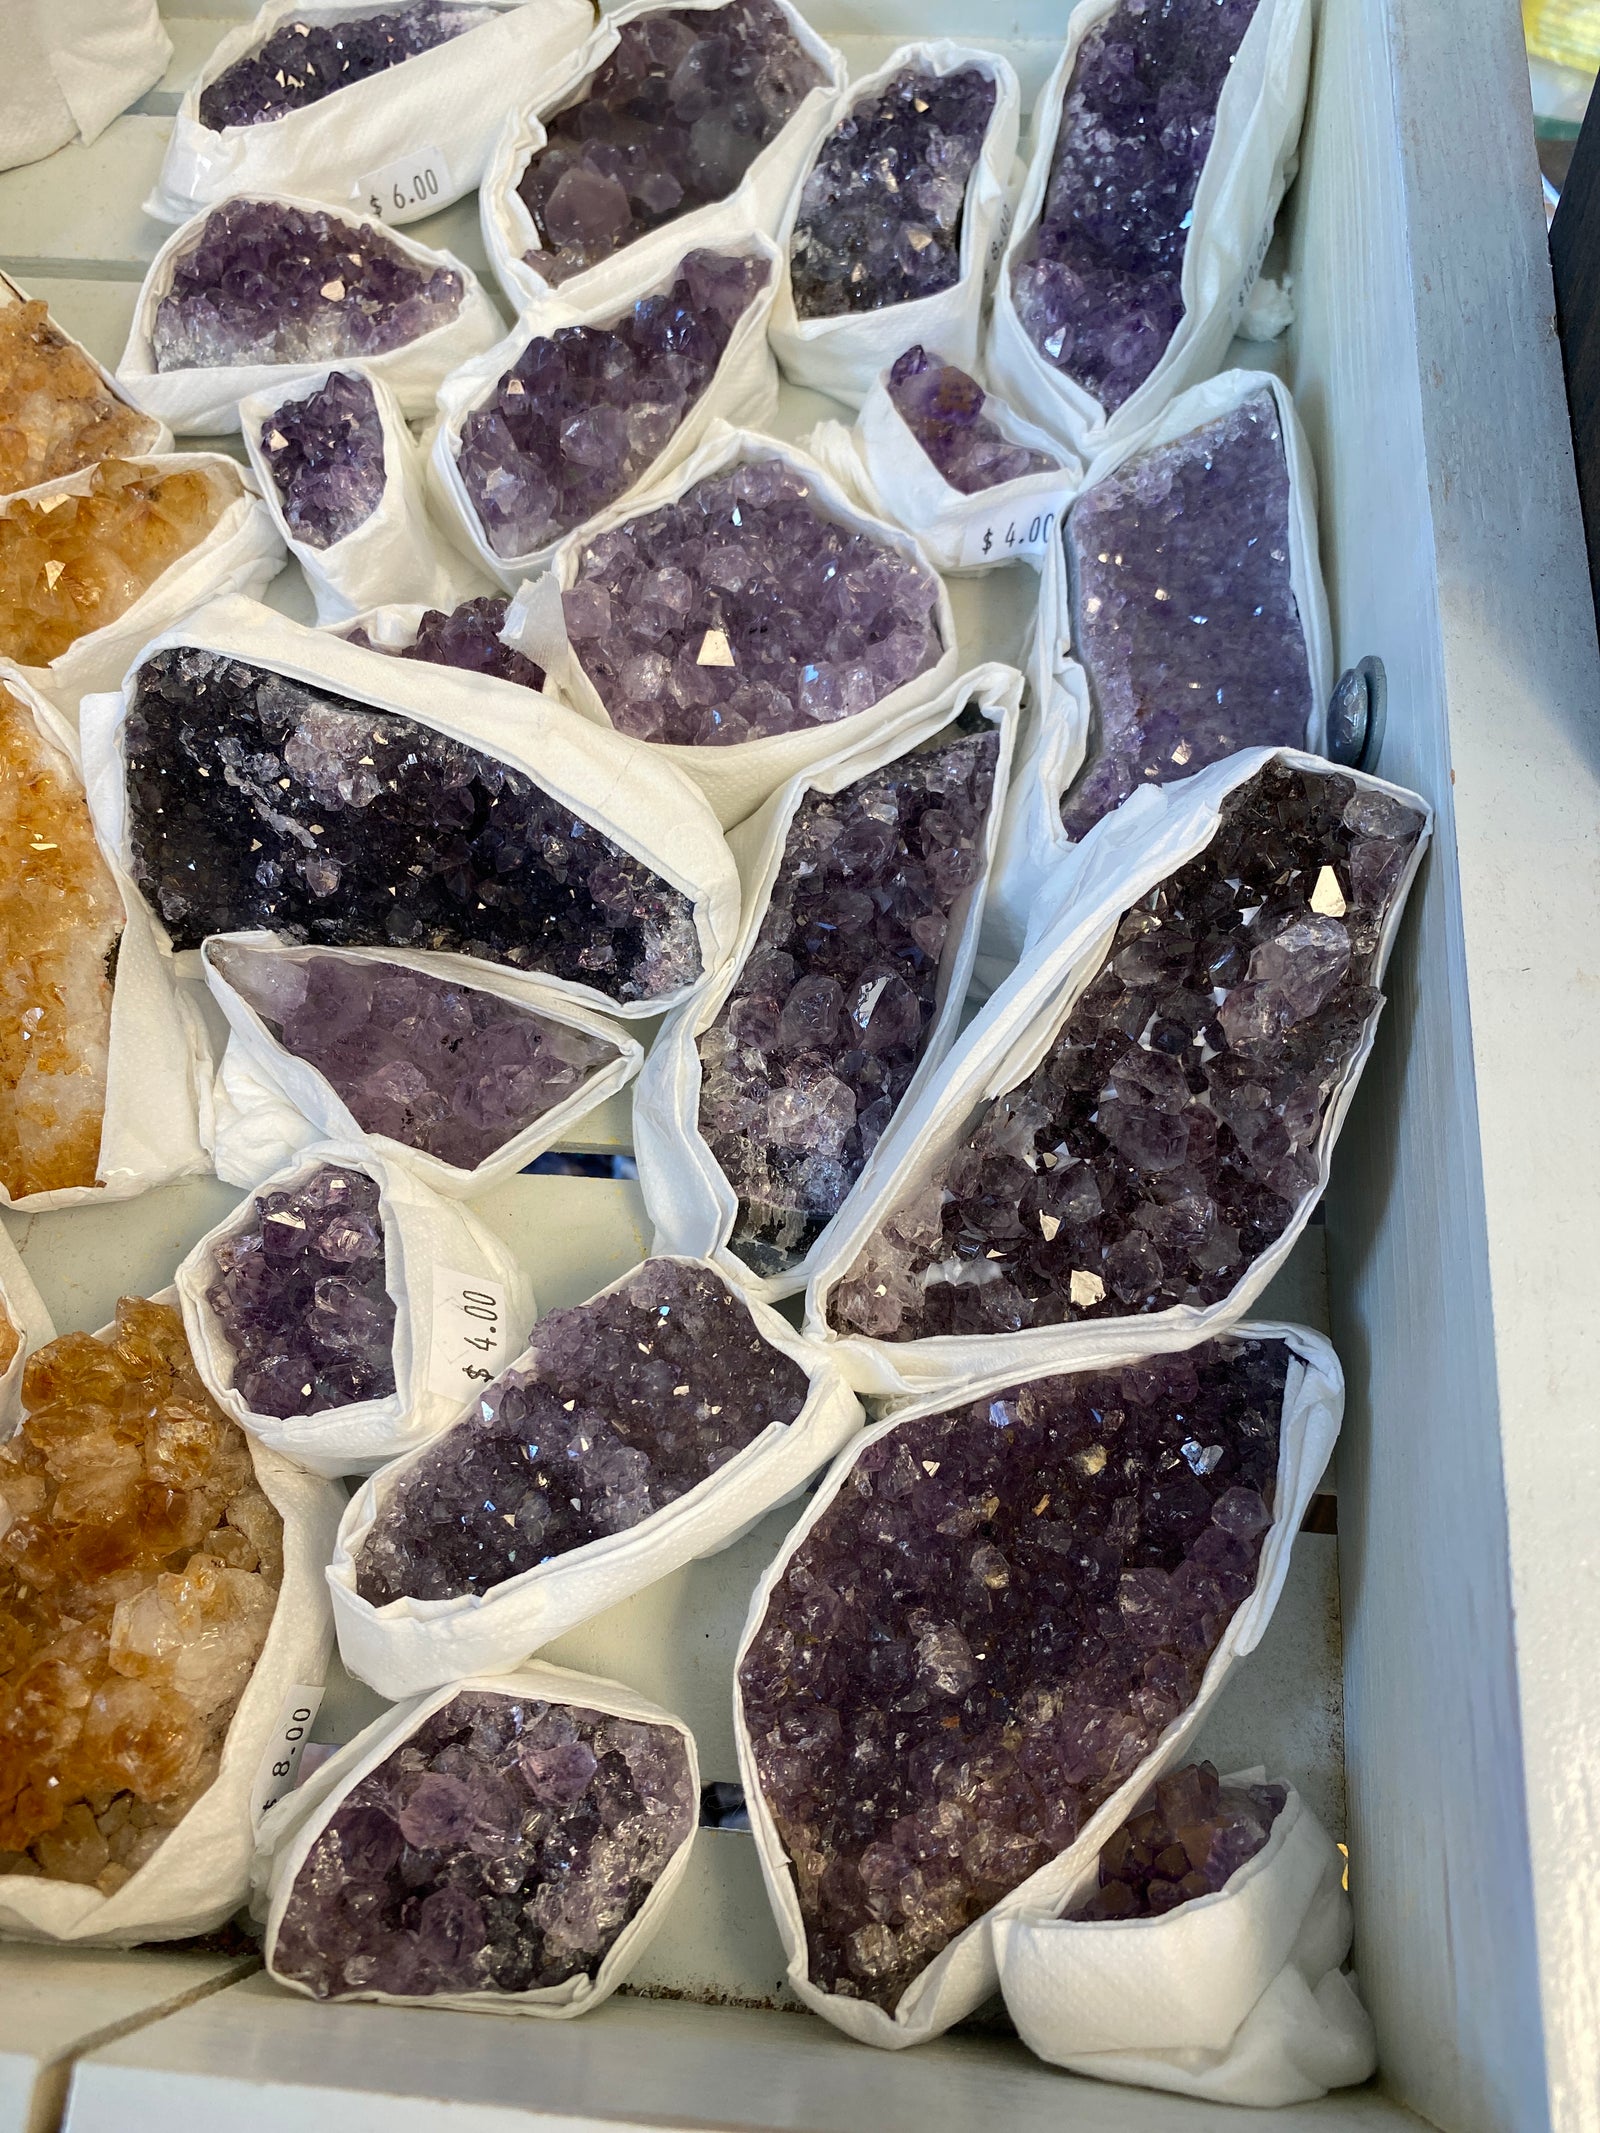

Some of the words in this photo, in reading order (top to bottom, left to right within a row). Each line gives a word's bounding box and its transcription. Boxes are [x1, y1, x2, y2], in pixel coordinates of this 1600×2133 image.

[393, 169, 438, 209] 6.00
[462, 1290, 498, 1351] 4.00
[272, 1708, 311, 1777] 8.00
